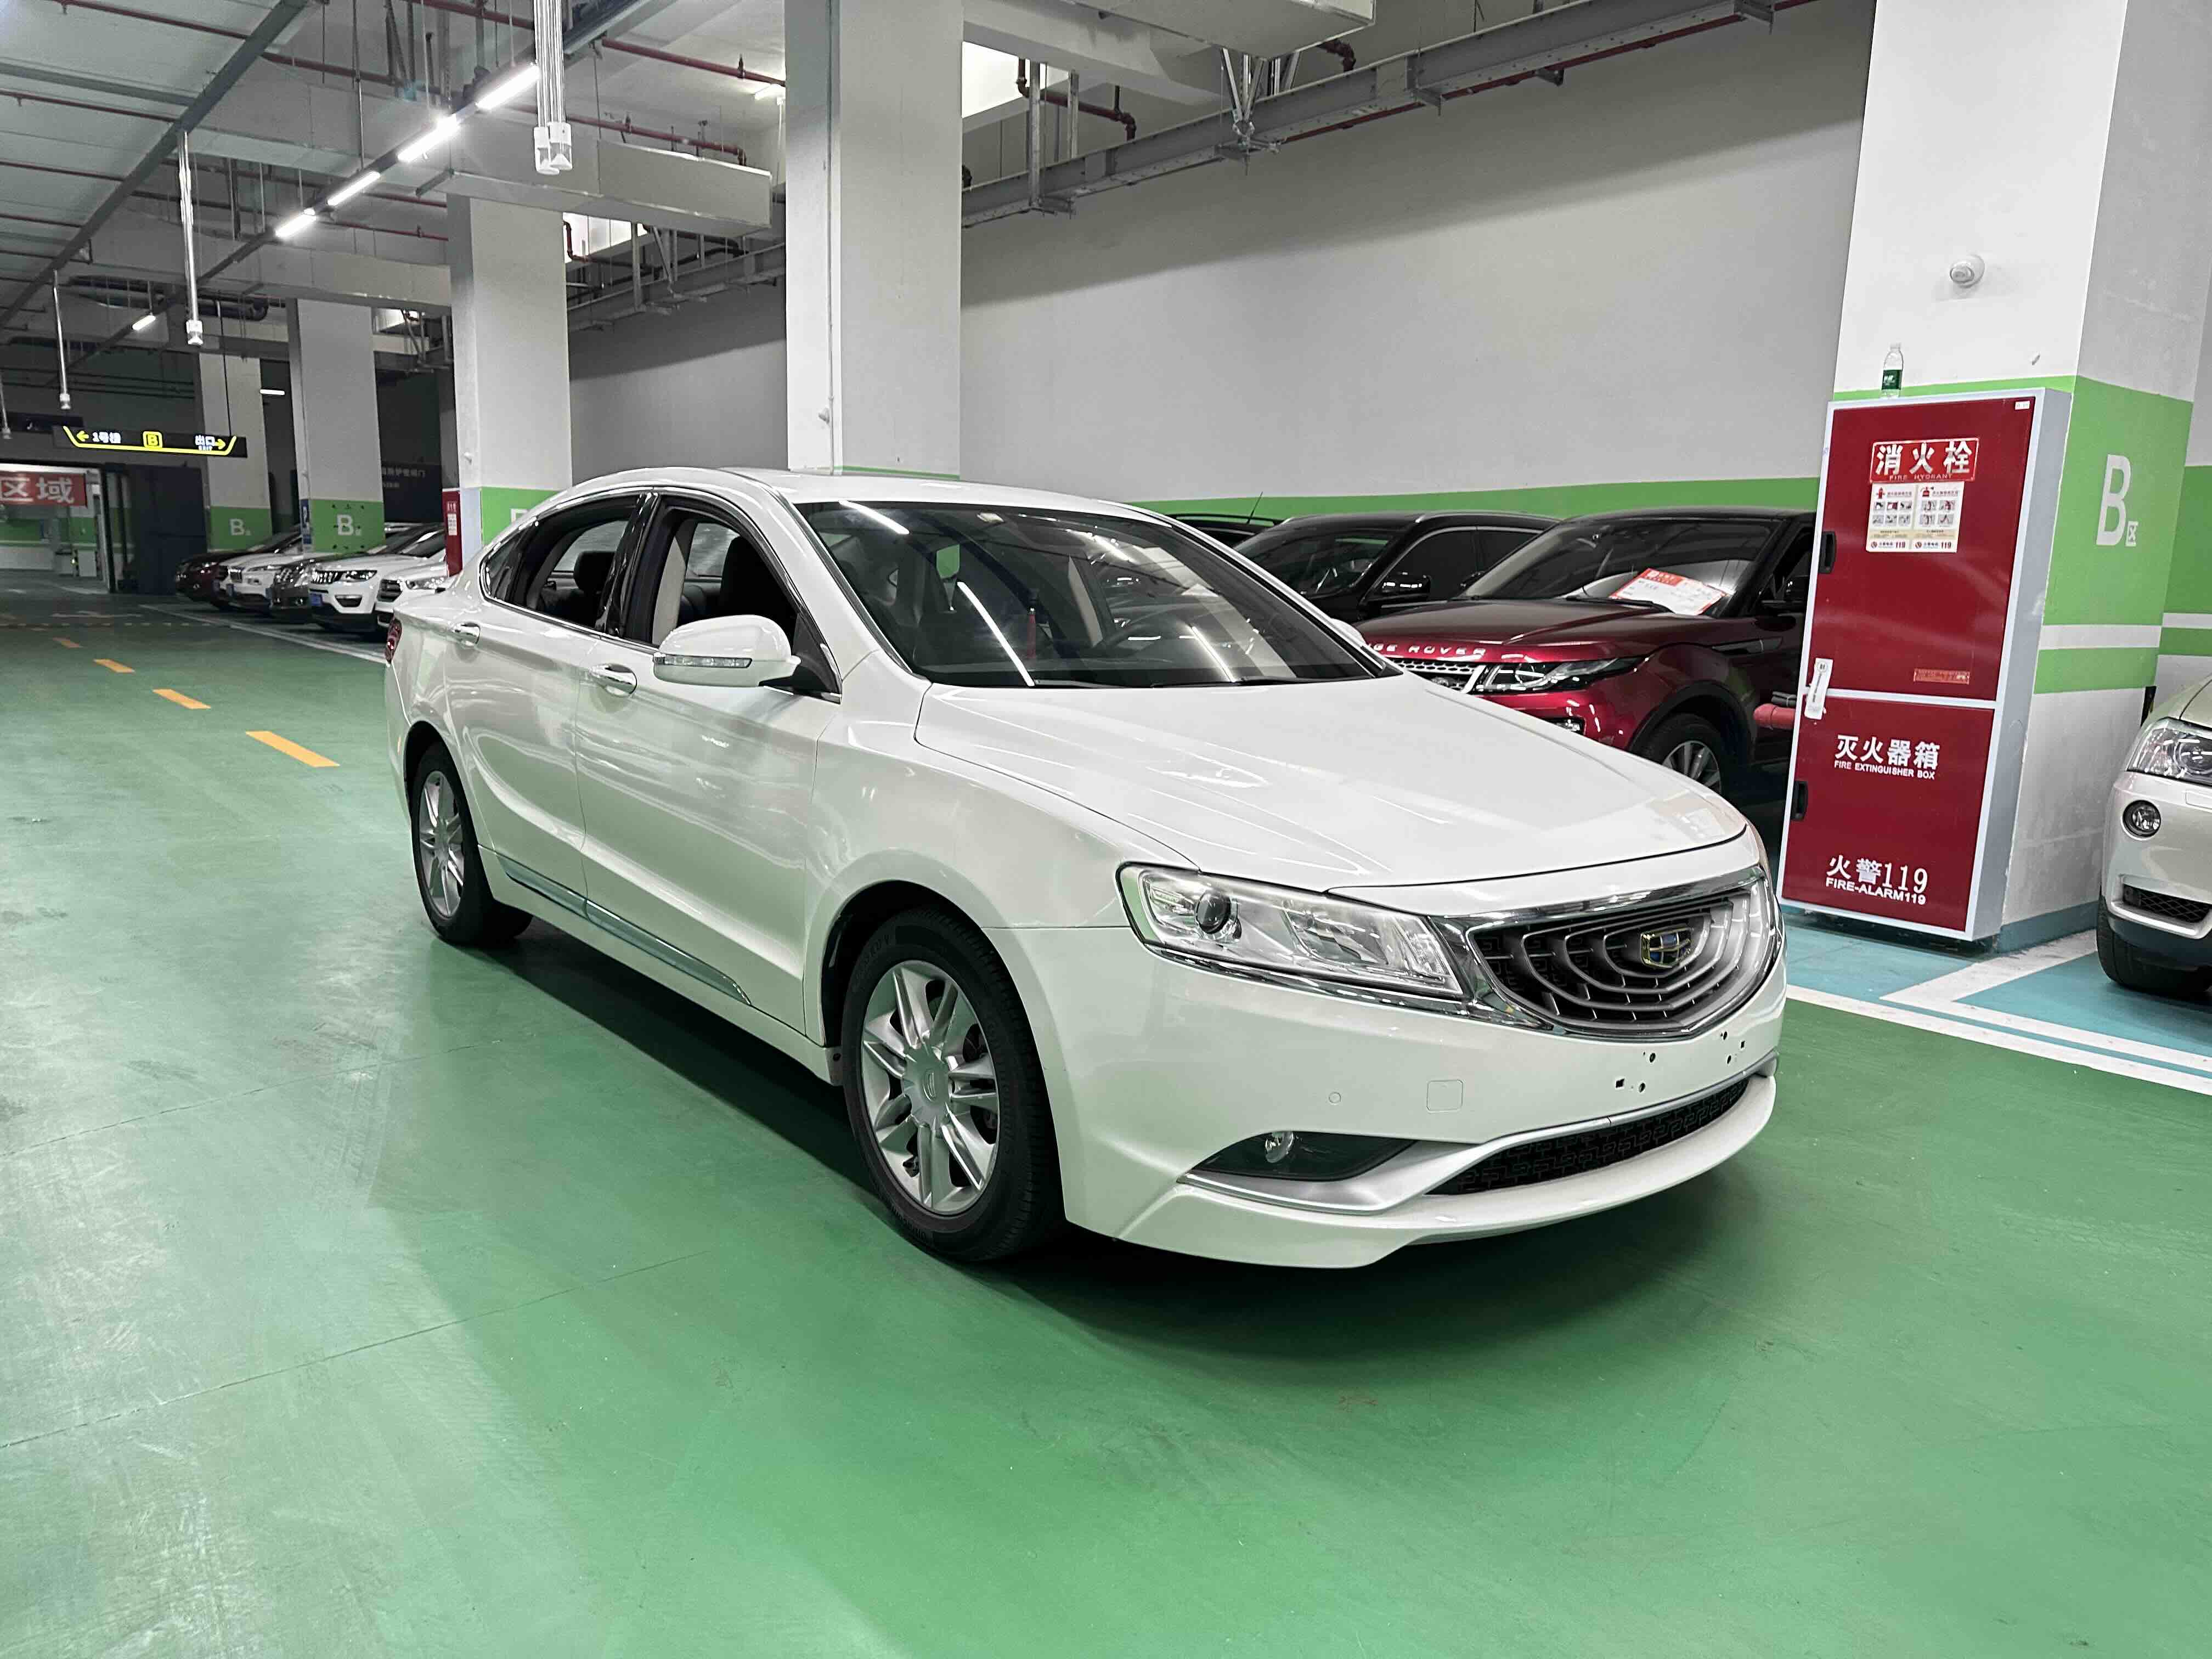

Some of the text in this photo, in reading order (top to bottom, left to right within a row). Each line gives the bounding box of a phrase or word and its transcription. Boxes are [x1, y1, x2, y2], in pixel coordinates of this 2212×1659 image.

[195, 435, 215, 446] 出口
[1876, 441, 1972, 475] 消火栓
[0, 477, 74, 504] 区域
[229, 518, 251, 536] B
[1408, 645, 1486, 656] ROVER
[1835, 735, 1940, 770] 灭火器箱
[1835, 760, 1935, 780] FIRE EXTINGUISHER BOX
[1826, 877, 1926, 905] FIRE-ALARM119
